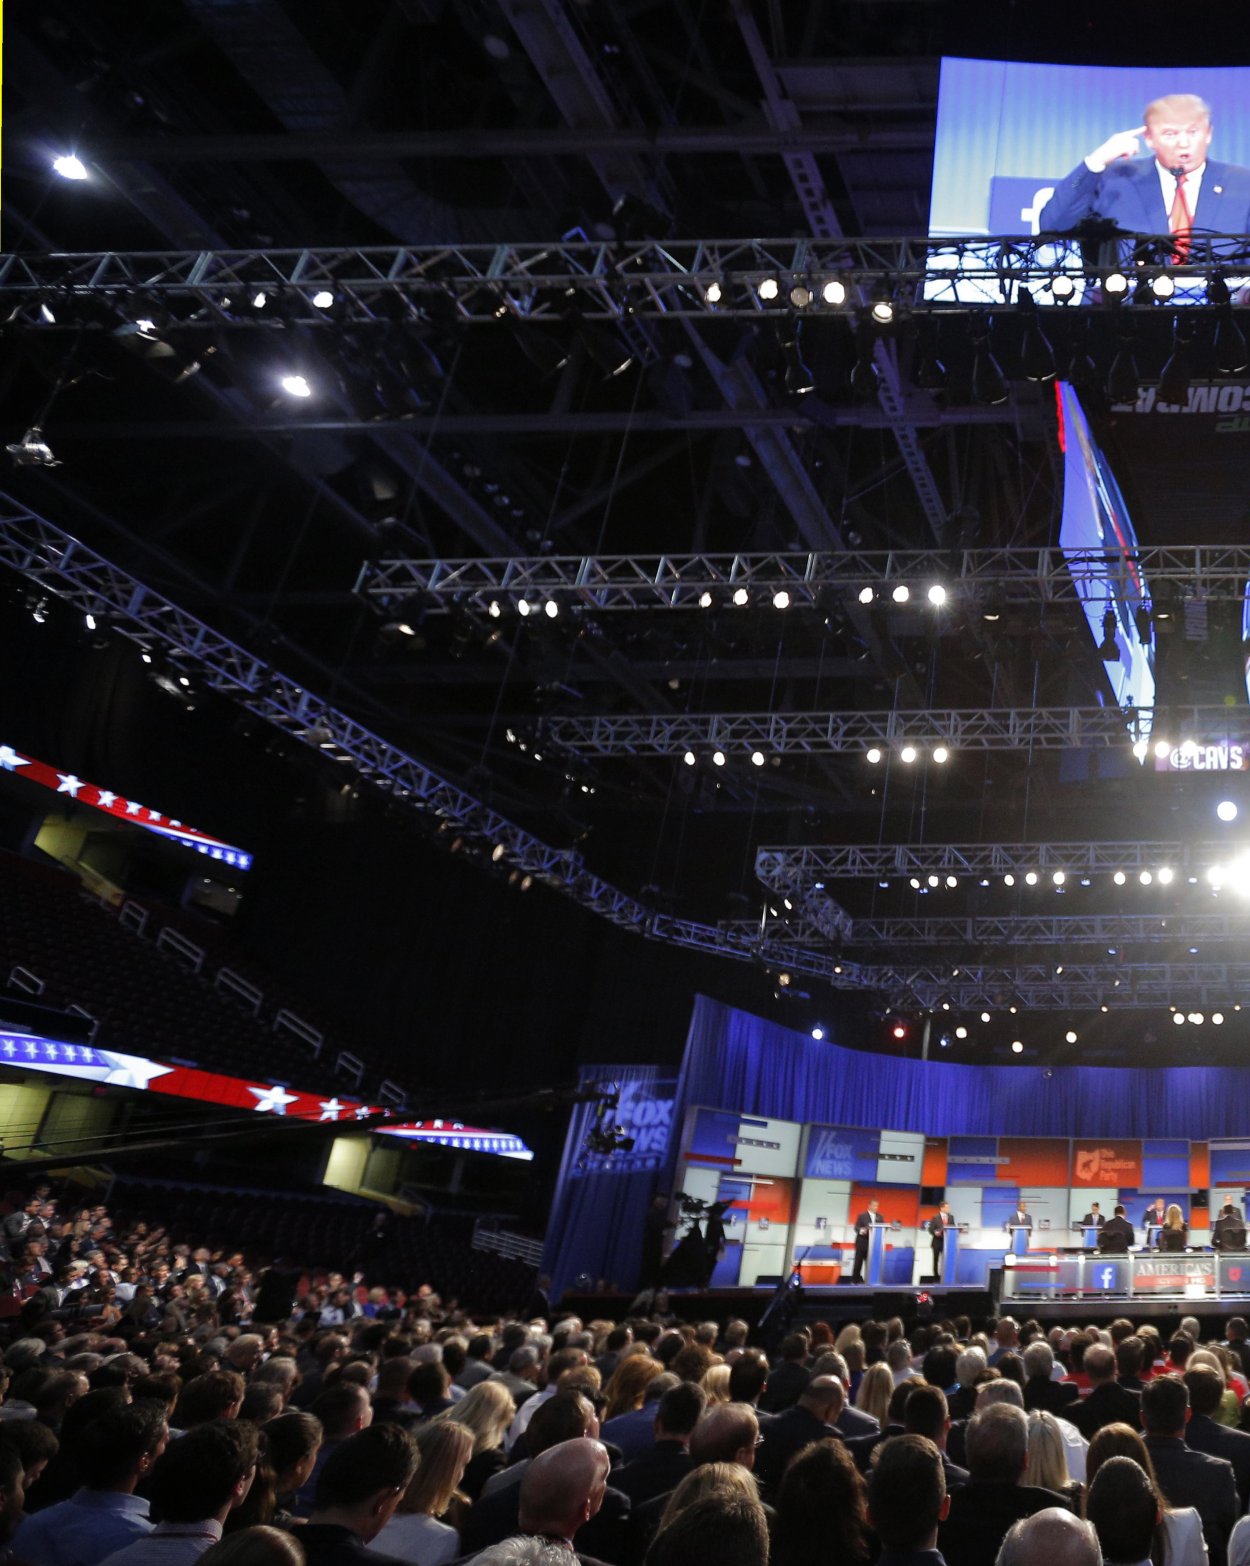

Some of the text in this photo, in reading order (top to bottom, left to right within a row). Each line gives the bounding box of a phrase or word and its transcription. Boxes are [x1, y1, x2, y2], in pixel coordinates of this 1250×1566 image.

[615, 1100, 673, 1127] FOX
[825, 1143, 853, 1159] FOX
[815, 1159, 852, 1177] NEWS
[1137, 1263, 1212, 1276] AMERICA'S
